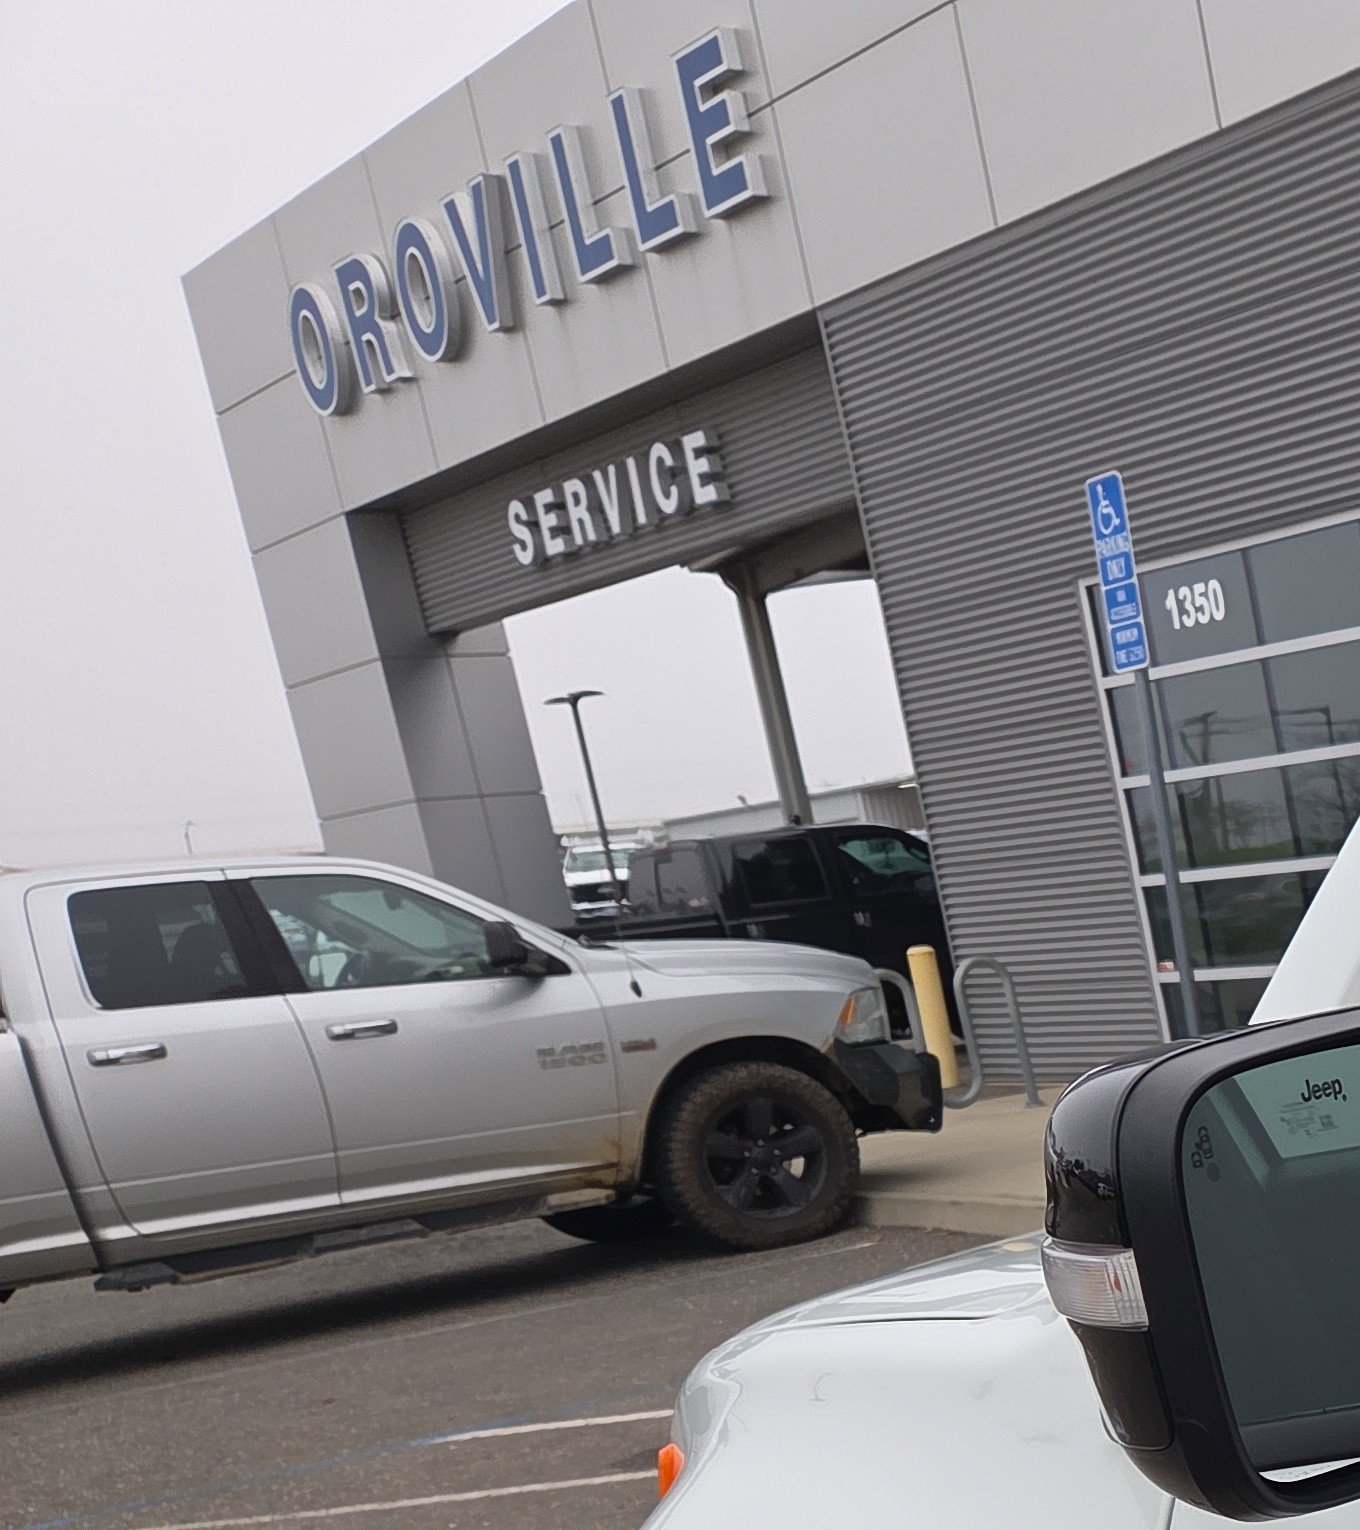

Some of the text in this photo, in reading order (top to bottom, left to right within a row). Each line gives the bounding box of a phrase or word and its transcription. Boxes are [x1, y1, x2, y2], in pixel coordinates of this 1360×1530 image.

[290, 27, 771, 416] OROVILLE
[506, 430, 719, 567] SERVICE
[1164, 579, 1226, 630] 1350
